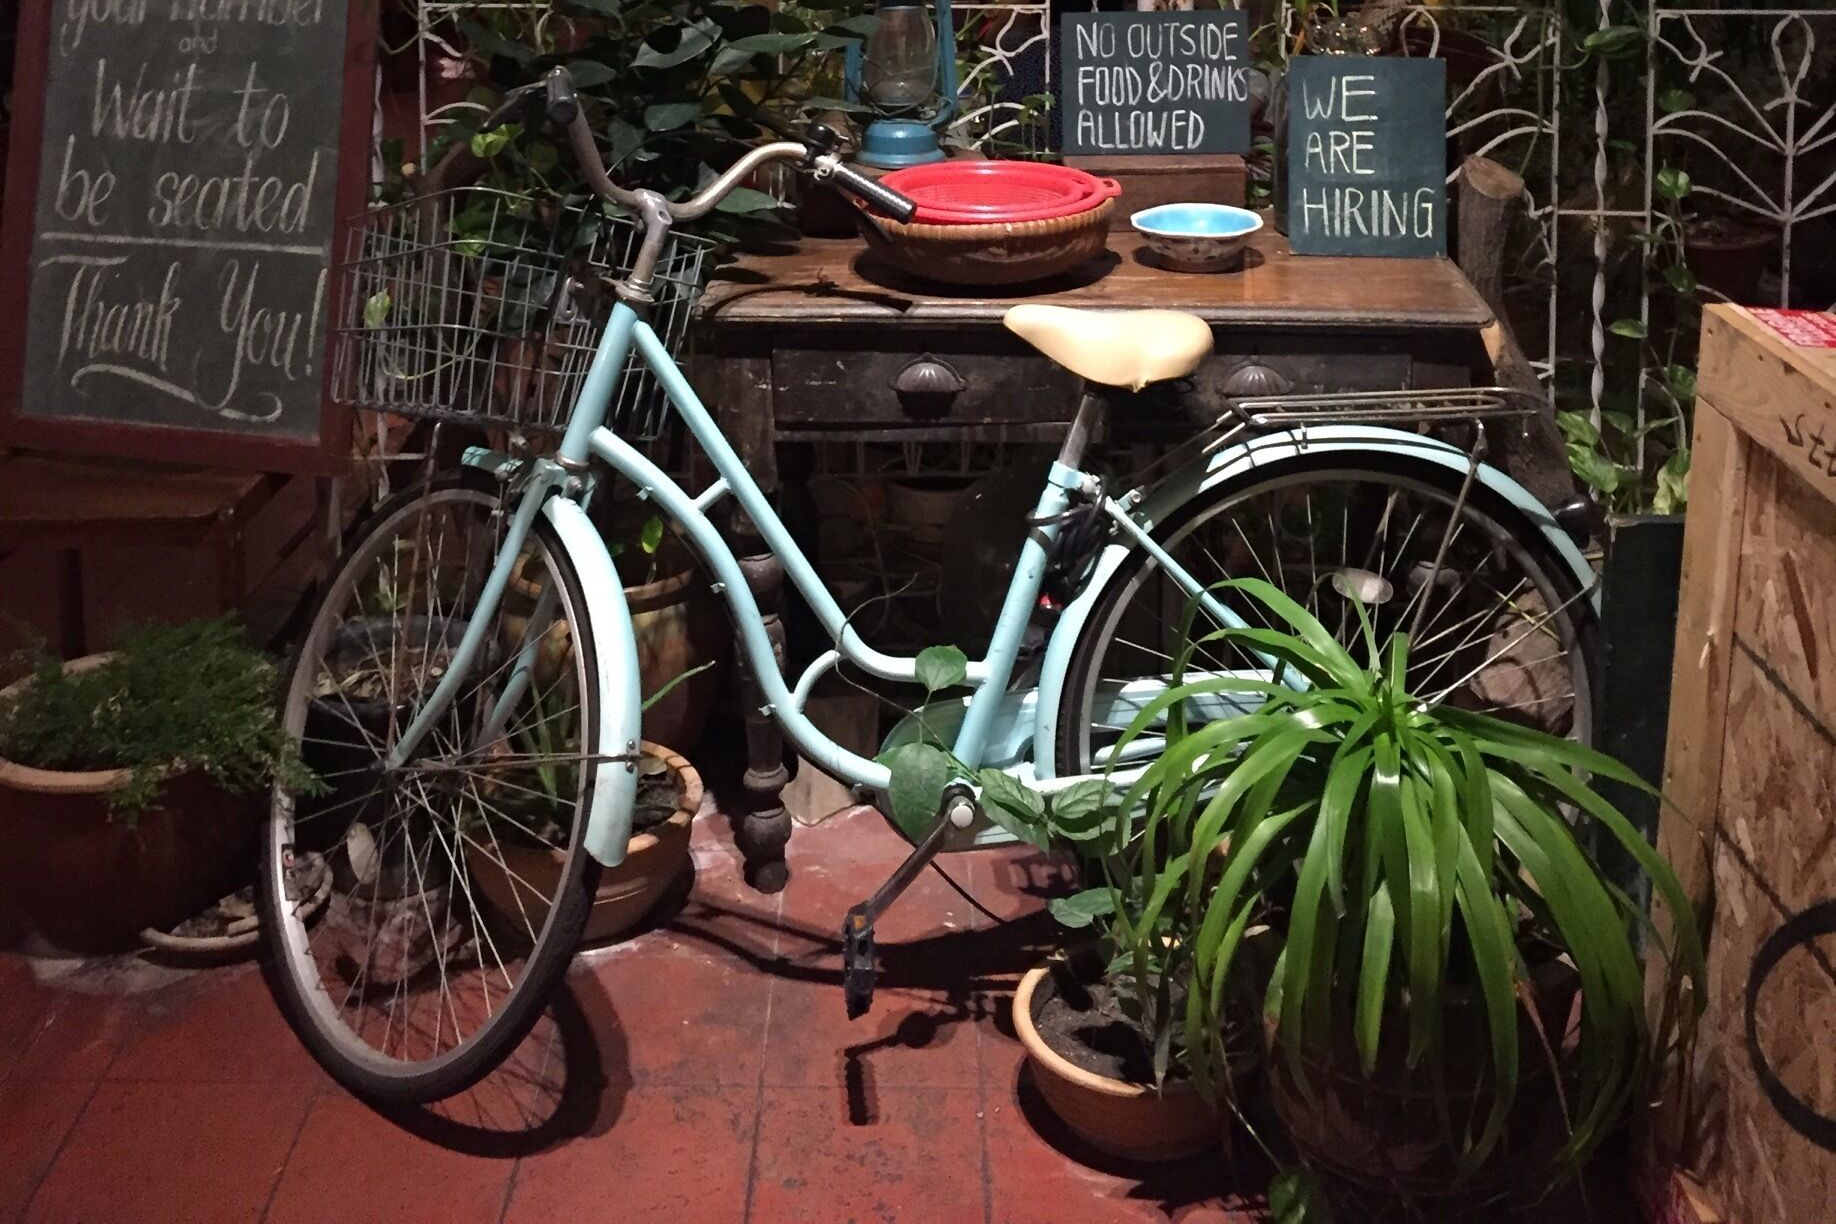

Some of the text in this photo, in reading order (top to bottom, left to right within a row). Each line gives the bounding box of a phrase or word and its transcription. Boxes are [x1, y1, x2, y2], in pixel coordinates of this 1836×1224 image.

[178, 31, 218, 55] and
[1076, 21, 1239, 62] NO OUTSIDE
[92, 57, 290, 149] Wait to
[1302, 75, 1380, 123] WE
[1076, 109, 1205, 151] ALLOWED
[1304, 130, 1376, 176] ARE
[54, 133, 320, 234] be seated
[1302, 187, 1435, 240] HIRING
[39, 255, 182, 374] Thank
